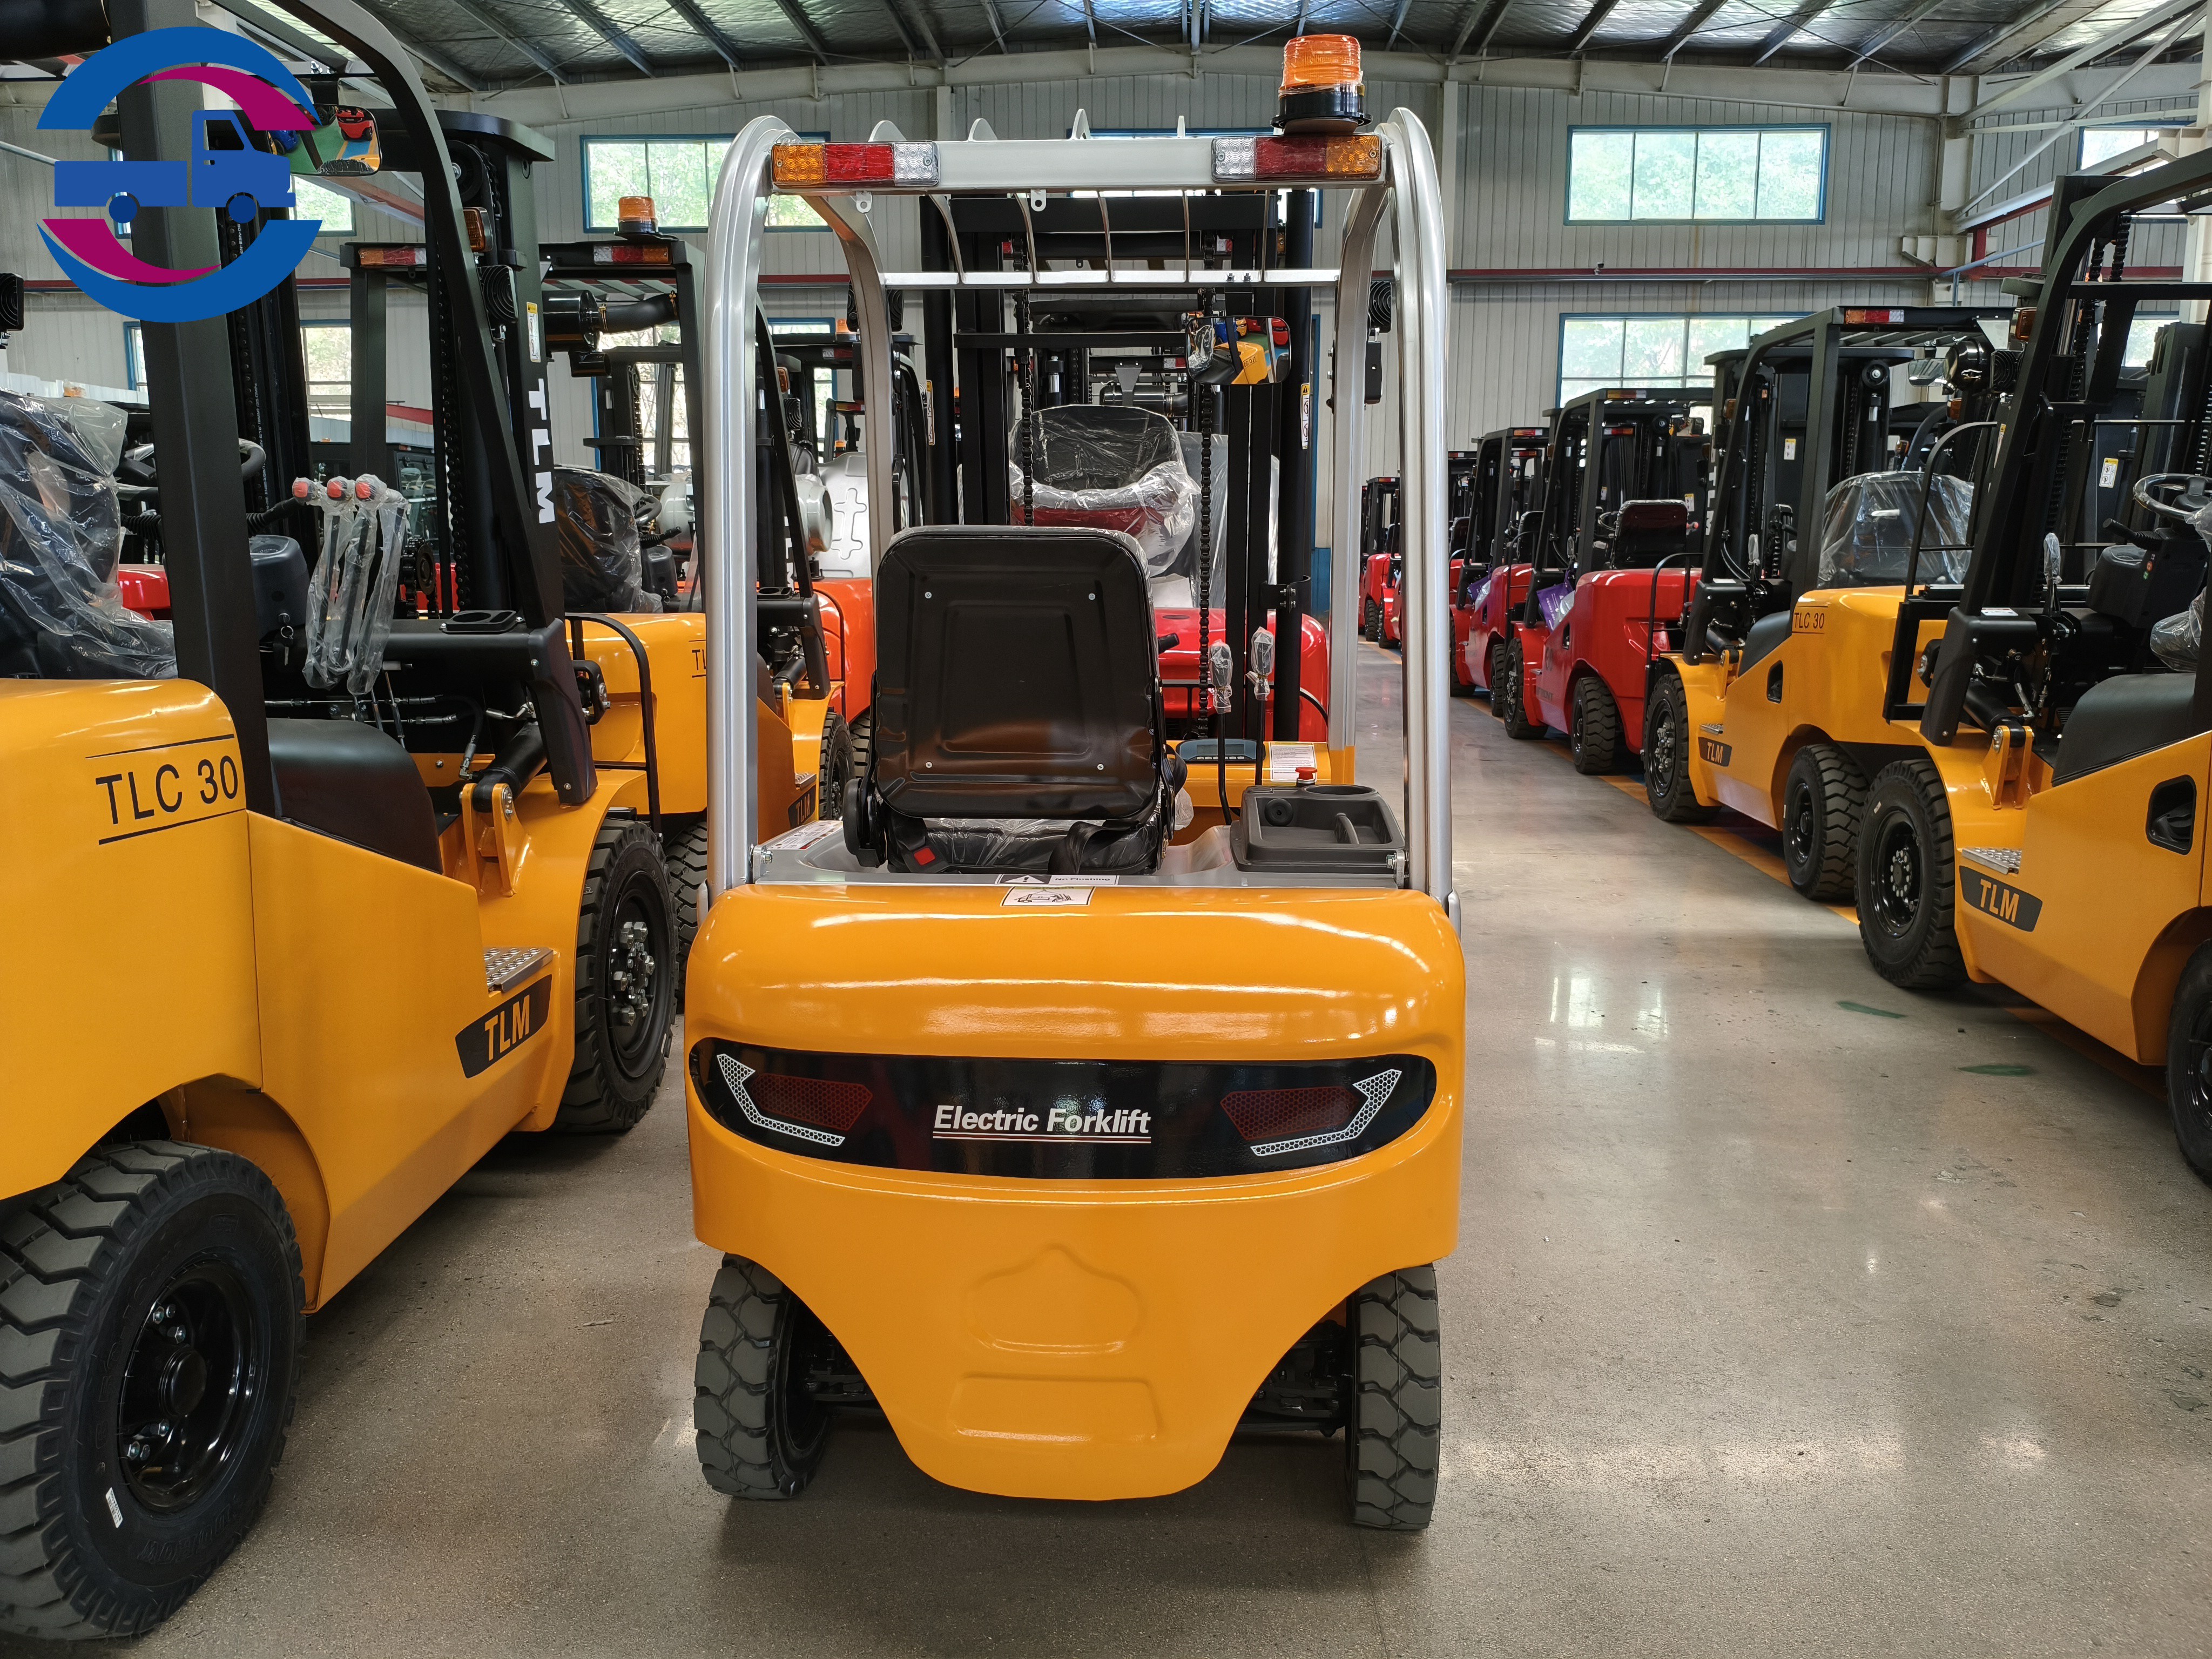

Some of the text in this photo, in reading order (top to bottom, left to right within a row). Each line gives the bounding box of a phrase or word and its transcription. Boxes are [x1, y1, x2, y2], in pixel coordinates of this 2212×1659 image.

[528, 378, 555, 524] TLM
[1705, 466, 1717, 536] TLM
[1793, 612, 1825, 629] TLC 30
[1707, 741, 1723, 764] TLM
[95, 755, 238, 825] TLC 30
[796, 793, 810, 825] TLM
[1980, 878, 2020, 923] TLM
[484, 994, 530, 1061] TLM
[934, 1105, 1152, 1134] Electric Forklift
